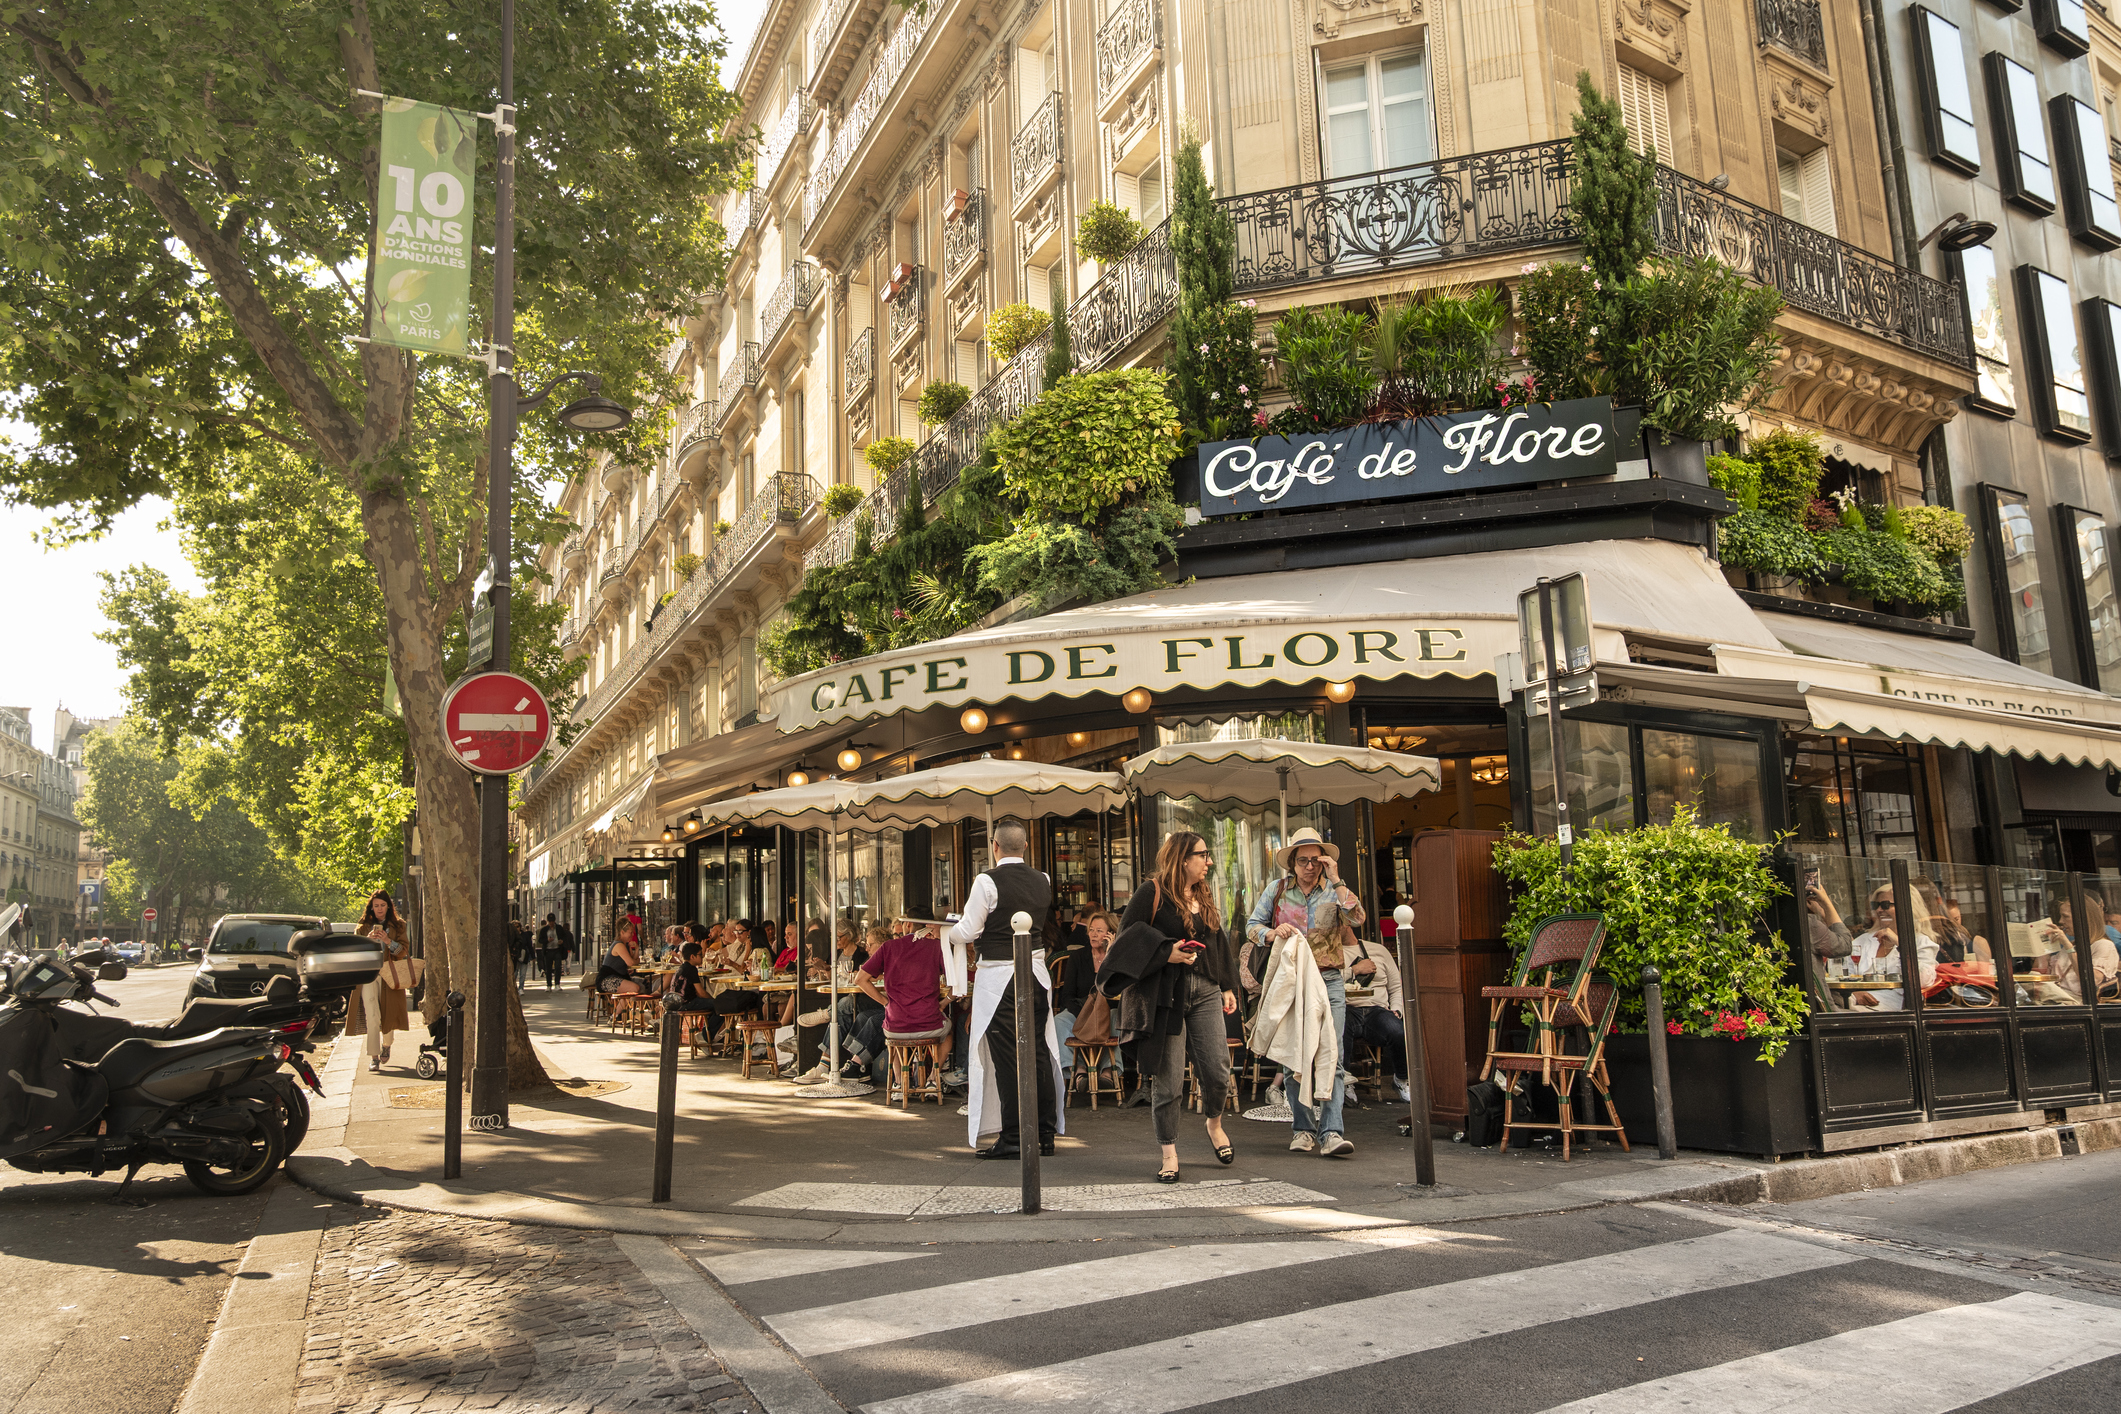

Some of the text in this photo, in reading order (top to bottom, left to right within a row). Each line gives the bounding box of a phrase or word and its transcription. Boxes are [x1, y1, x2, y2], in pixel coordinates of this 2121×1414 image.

[388, 164, 465, 218] 10
[386, 214, 464, 244] ANS
[380, 247, 467, 269] MONDIALES
[385, 237, 463, 257] D'ACTIONS
[400, 324, 441, 340] PARIS
[1204, 412, 1606, 504] Café de Flore
[811, 628, 1468, 714] CAFE DE FLORE
[84, 885, 95, 894] P
